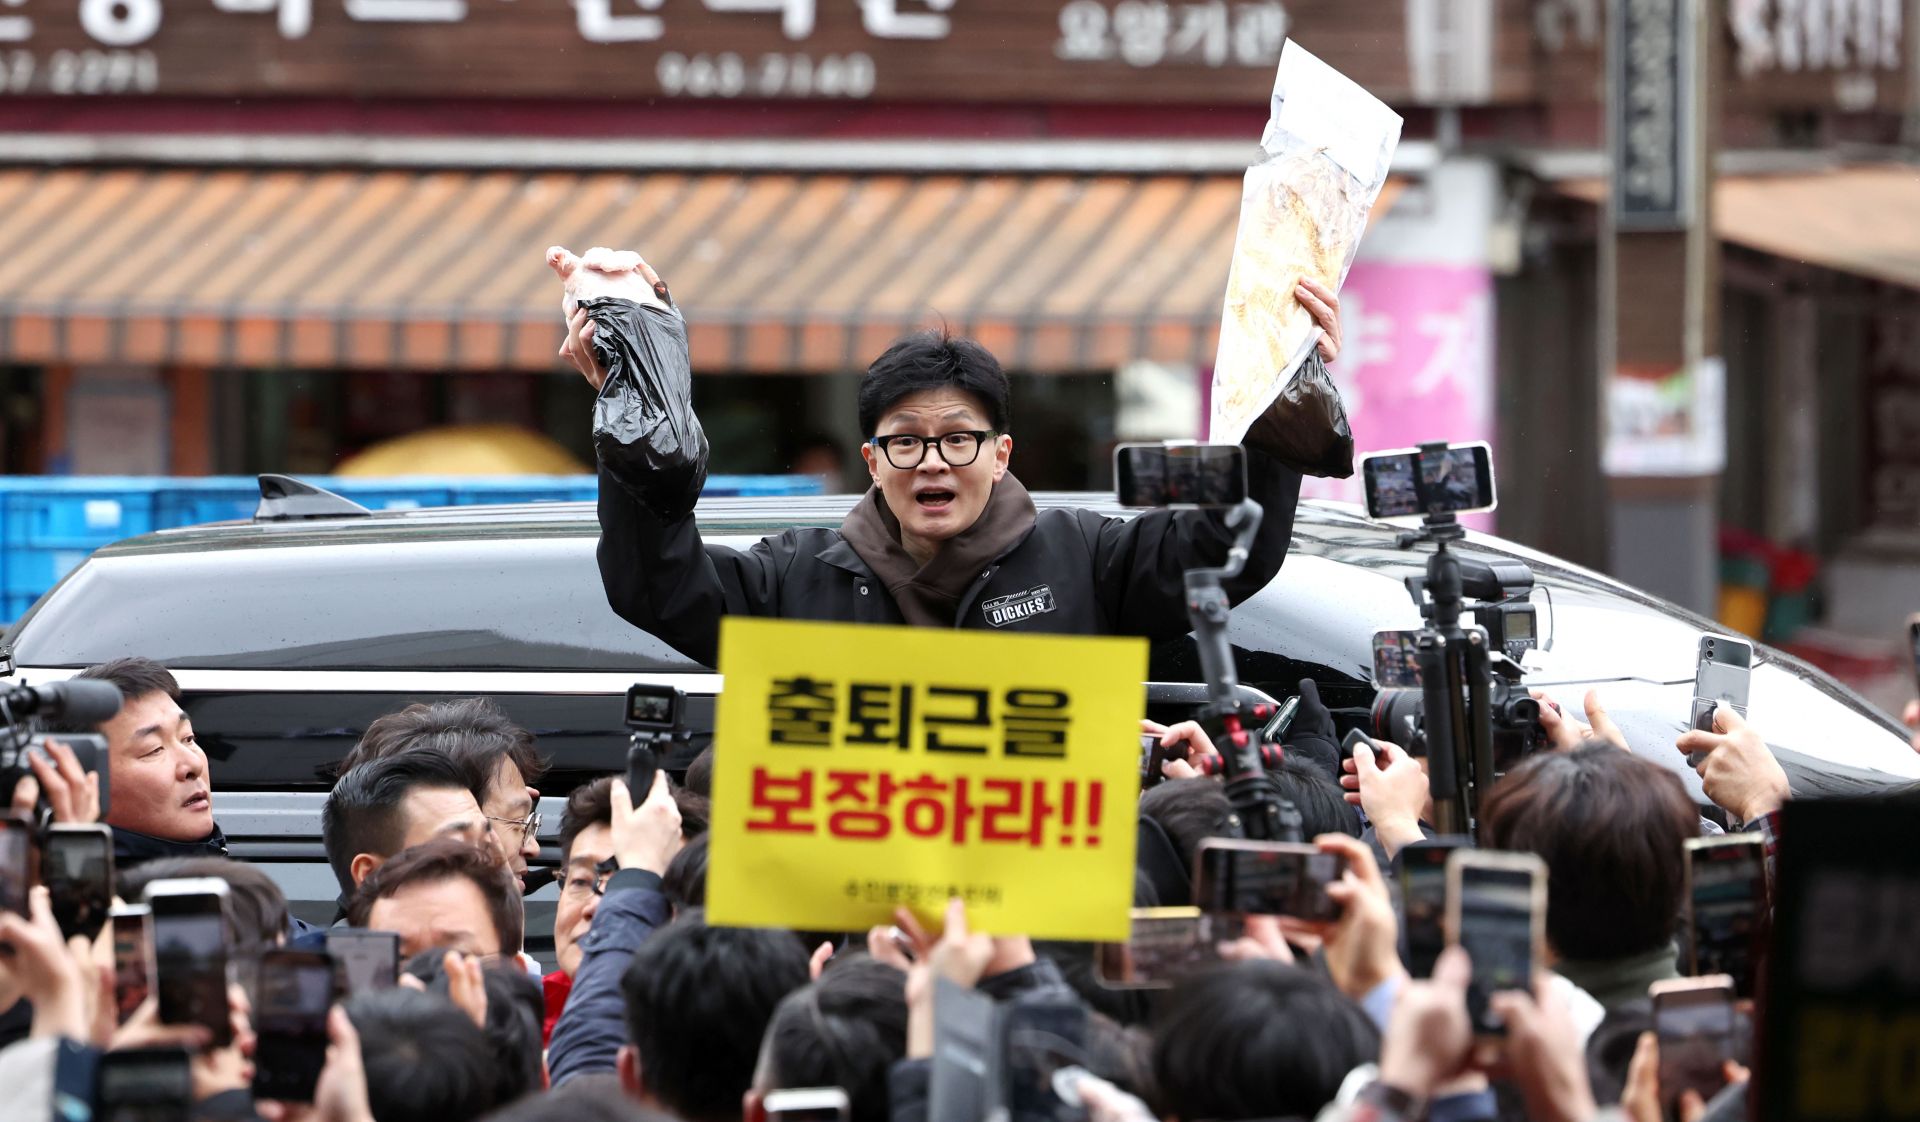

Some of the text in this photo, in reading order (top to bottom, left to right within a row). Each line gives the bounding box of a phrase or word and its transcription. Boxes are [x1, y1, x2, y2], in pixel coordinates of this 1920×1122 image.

[992, 597, 1045, 624] DICKIES
[767, 676, 1072, 759] 출퇴근을
[746, 767, 1104, 848] 보장하라!!
